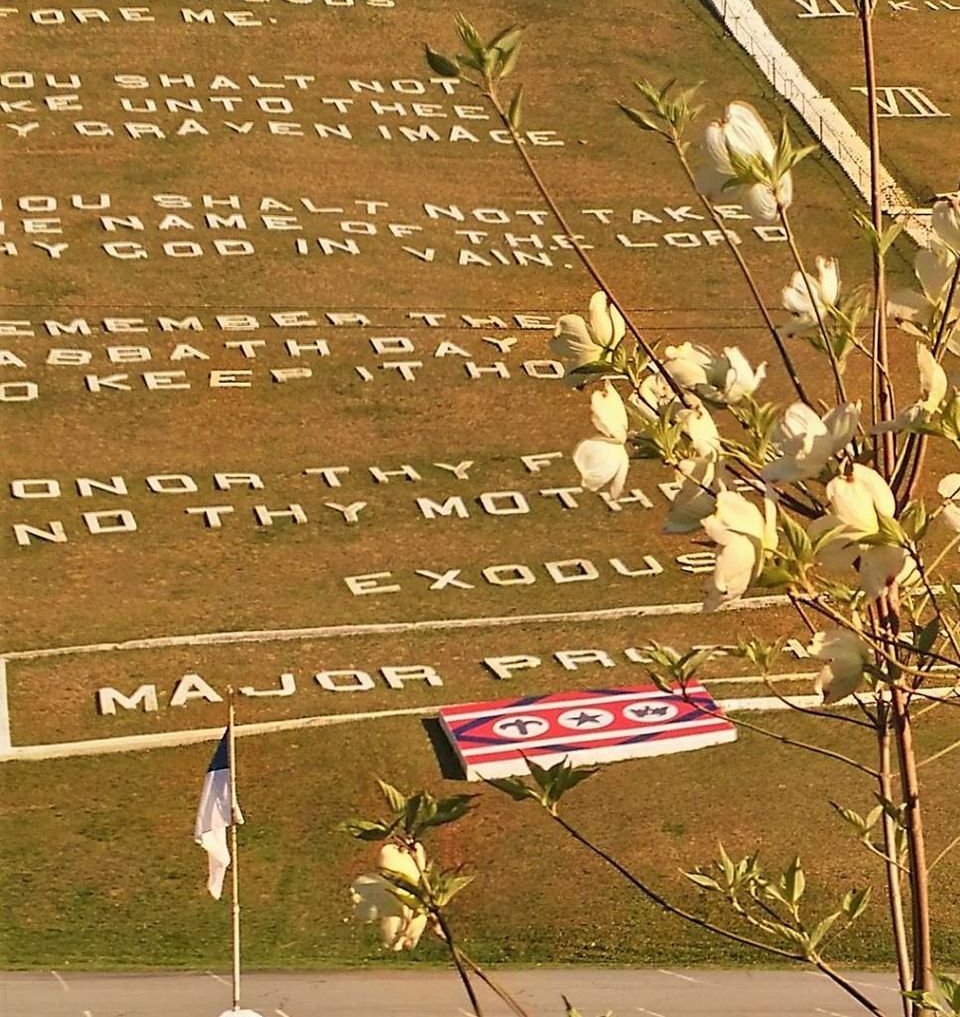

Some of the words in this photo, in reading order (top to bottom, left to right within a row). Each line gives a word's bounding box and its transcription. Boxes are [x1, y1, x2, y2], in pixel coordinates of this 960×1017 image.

[114, 73, 314, 90] SHALT
[349, 78, 461, 95] NOT
[120, 95, 293, 114] UNTO
[322, 97, 490, 120] THEE
[5, 122, 40, 138] Y
[73, 119, 352, 140] GRAVEN
[153, 193, 389, 215] SHALT
[423, 202, 548, 226] NOT
[582, 204, 753, 226] TAKE
[100, 213, 303, 232] NAME
[340, 220, 422, 238] OF
[455, 229, 595, 249] THE
[617, 224, 790, 250] LORD
[102, 238, 256, 260] GOD
[297, 237, 361, 256] IN
[405, 312, 556, 329] THE
[370, 336, 518, 358] DAY
[84, 367, 313, 393] KEEP
[355, 360, 424, 382] IT
[11, 473, 264, 499] ONOR
[303, 460, 475, 488] THY
[12, 509, 138, 546] ND
[184, 501, 368, 528] THY
[344, 550, 717, 597] EXODUS
[98, 664, 443, 716] MAJOR
